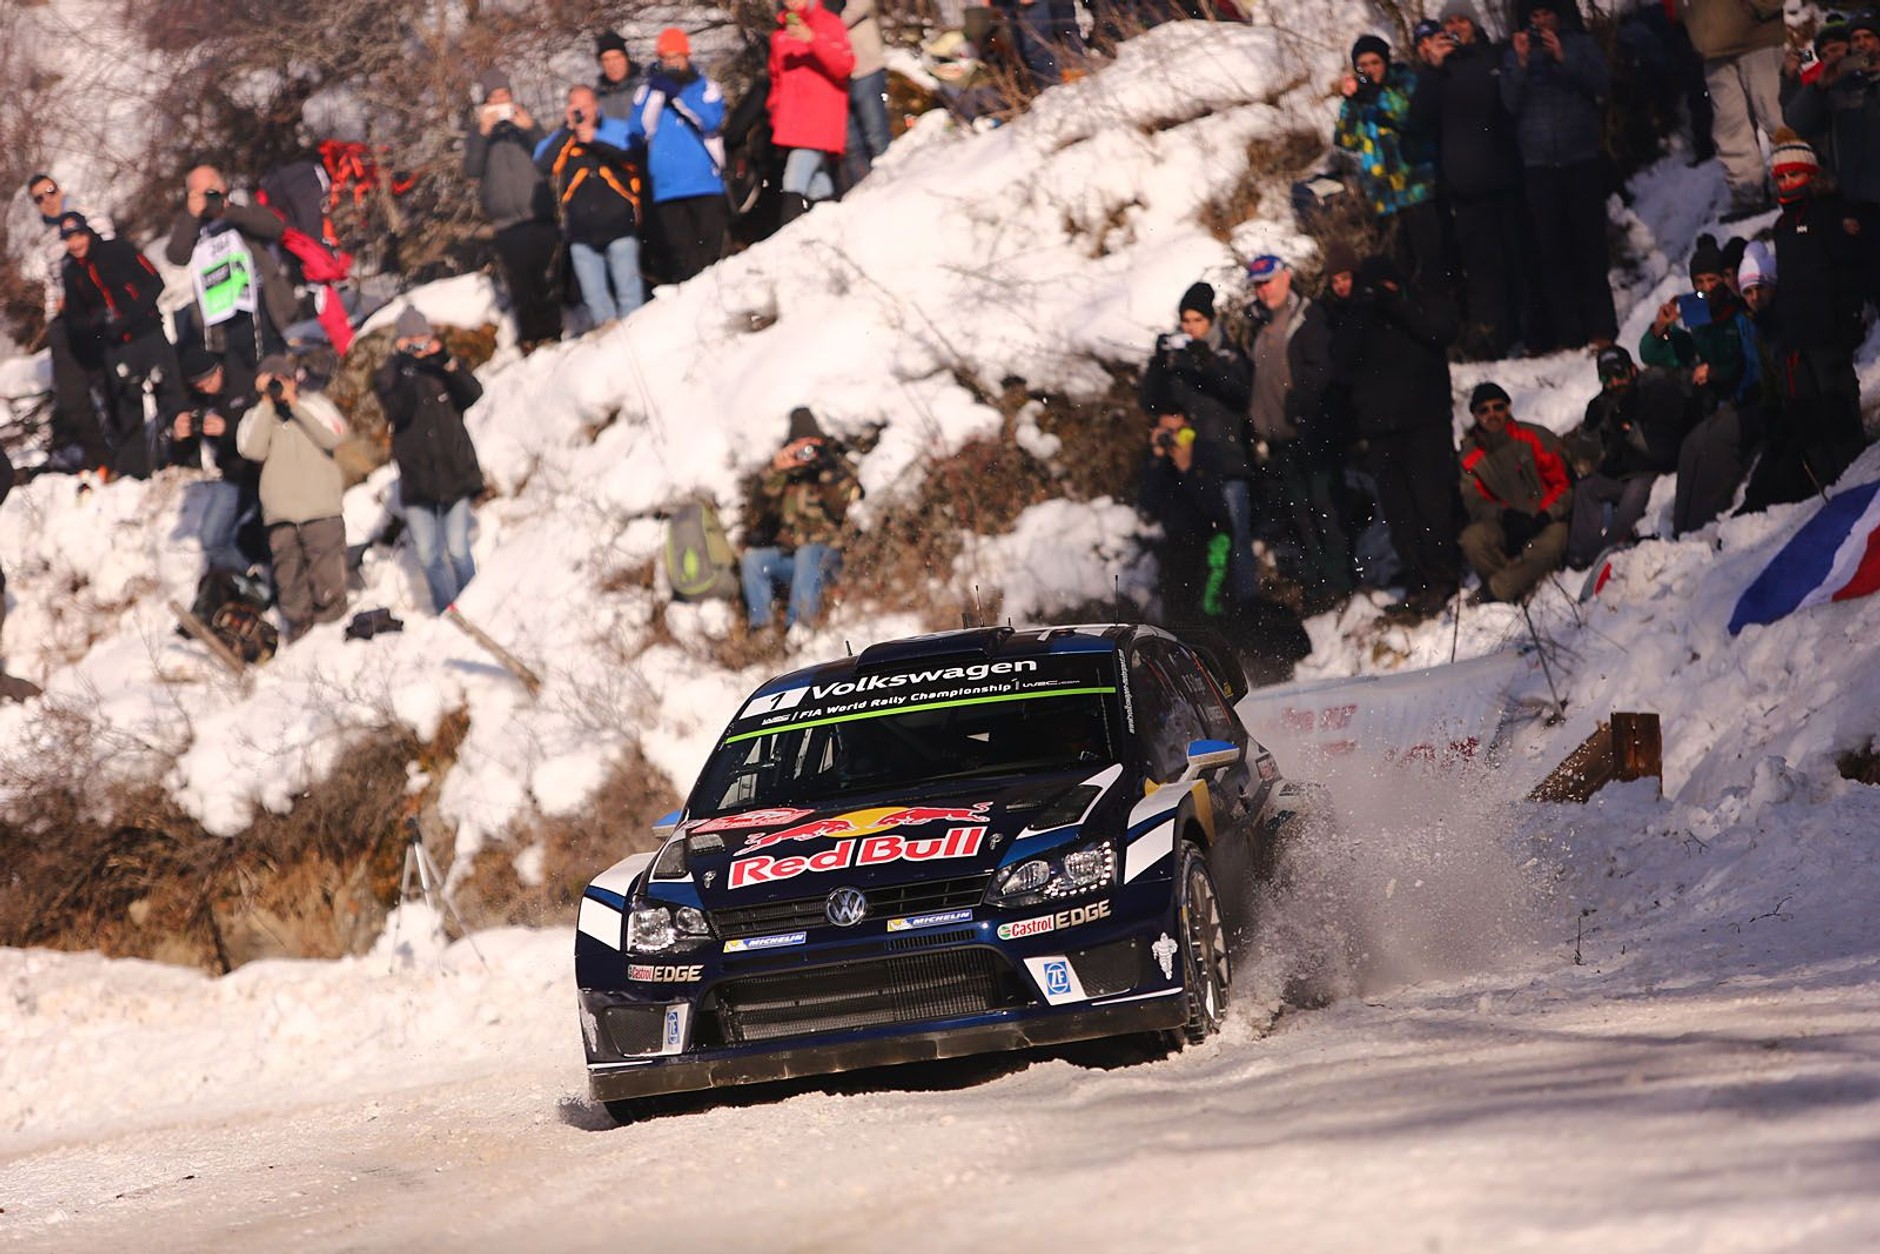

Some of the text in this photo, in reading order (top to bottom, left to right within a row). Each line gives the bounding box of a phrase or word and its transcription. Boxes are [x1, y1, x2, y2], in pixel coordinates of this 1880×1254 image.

[811, 660, 1037, 699] Volkswagen
[770, 692, 782, 710] 1
[799, 709, 822, 719] FIA
[826, 701, 866, 714] World
[870, 694, 906, 708] Rally
[910, 683, 1011, 701] Championship
[730, 827, 984, 887] Red Bull
[830, 889, 864, 923] VW
[912, 911, 970, 925] MICHELIN
[1011, 899, 1111, 937] Castrol EDGE
[748, 934, 804, 946] MICHELIN
[632, 965, 704, 982] Castrol EDGE
